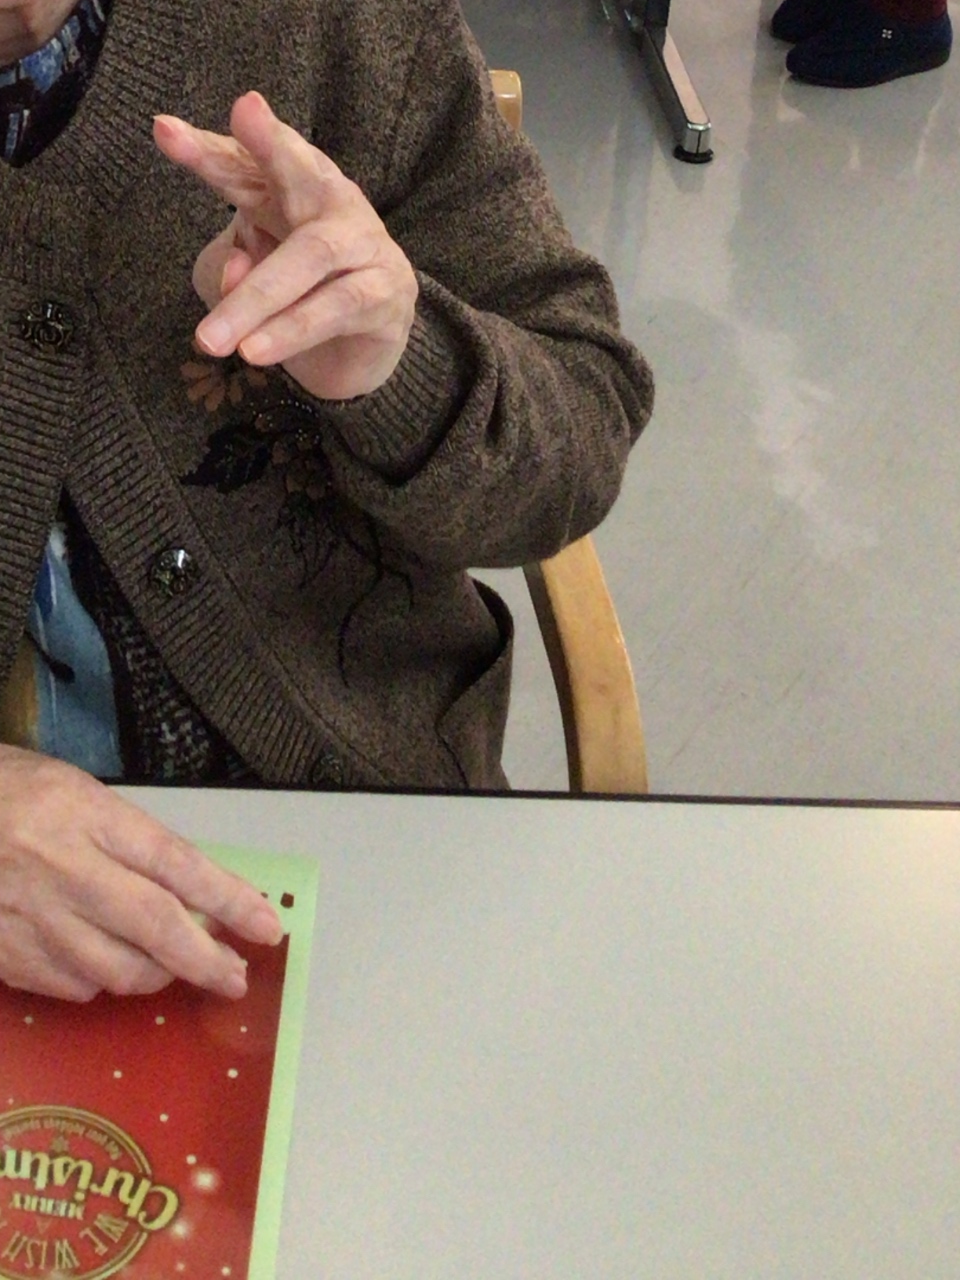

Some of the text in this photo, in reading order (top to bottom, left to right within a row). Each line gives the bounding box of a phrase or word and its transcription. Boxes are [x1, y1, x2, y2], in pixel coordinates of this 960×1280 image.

[10, 1193, 85, 1220] MERRY
[1, 1231, 80, 1269] WISH
[79, 1213, 129, 1256] WE
